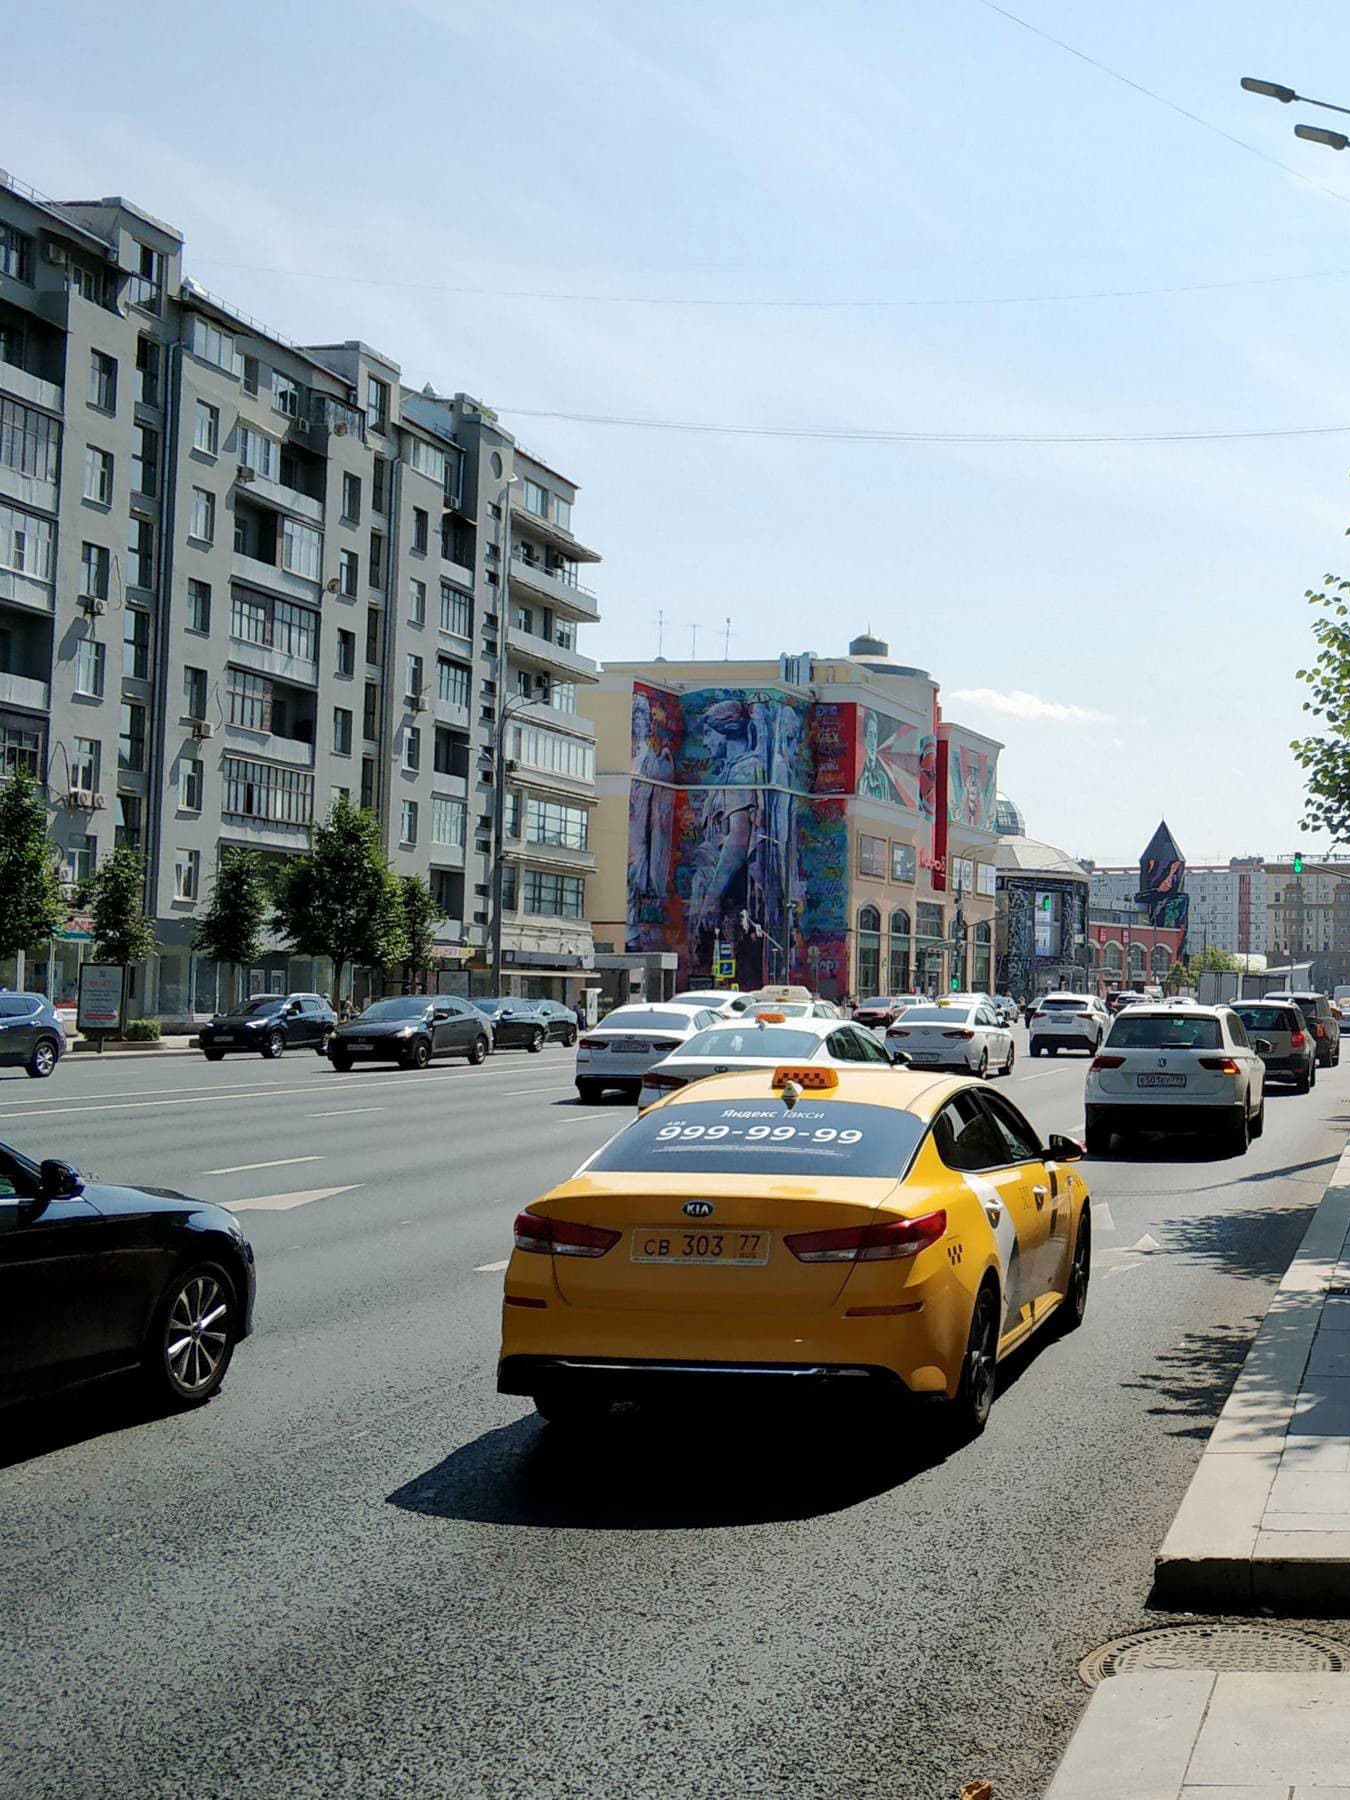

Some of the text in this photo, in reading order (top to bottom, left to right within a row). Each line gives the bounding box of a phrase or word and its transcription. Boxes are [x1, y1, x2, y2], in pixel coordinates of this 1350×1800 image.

[720, 1108, 778, 1119] Яндекс
[655, 1125, 863, 1144] 999-99-99
[686, 1204, 710, 1215] KIA
[643, 1234, 761, 1256] СВ 303 77
